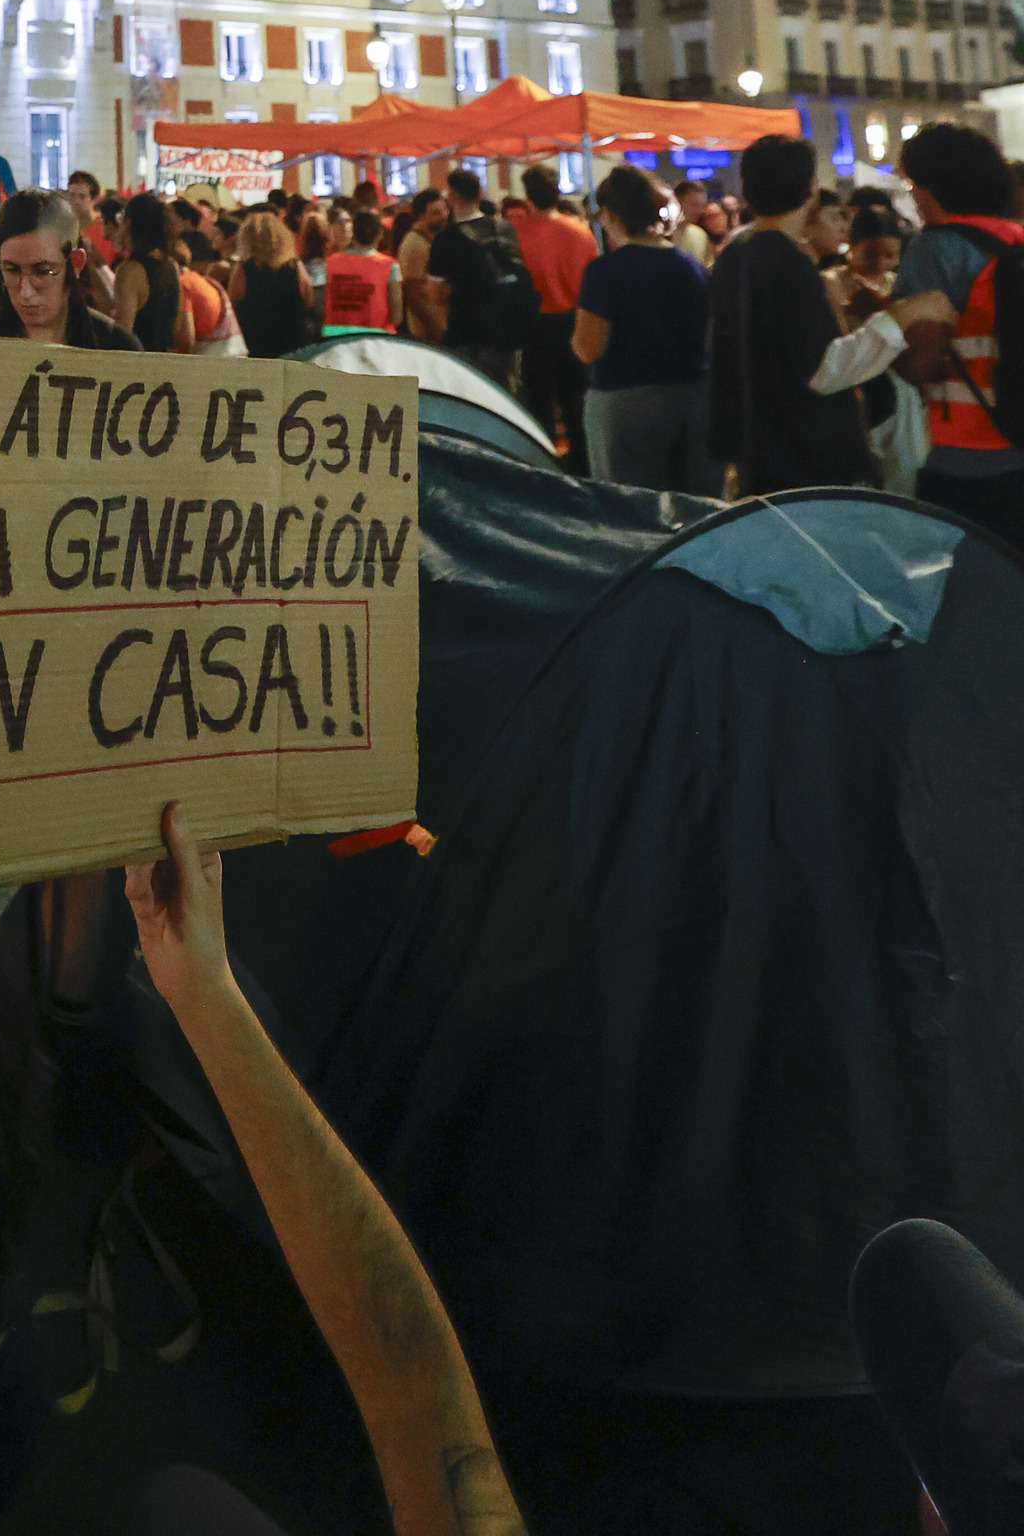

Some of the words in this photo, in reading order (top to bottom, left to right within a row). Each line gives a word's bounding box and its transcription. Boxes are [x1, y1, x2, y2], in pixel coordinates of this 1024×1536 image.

[200, 388, 264, 463] DE
[44, 491, 411, 594] GENERACIÓN
[88, 624, 364, 749] CASA!!
